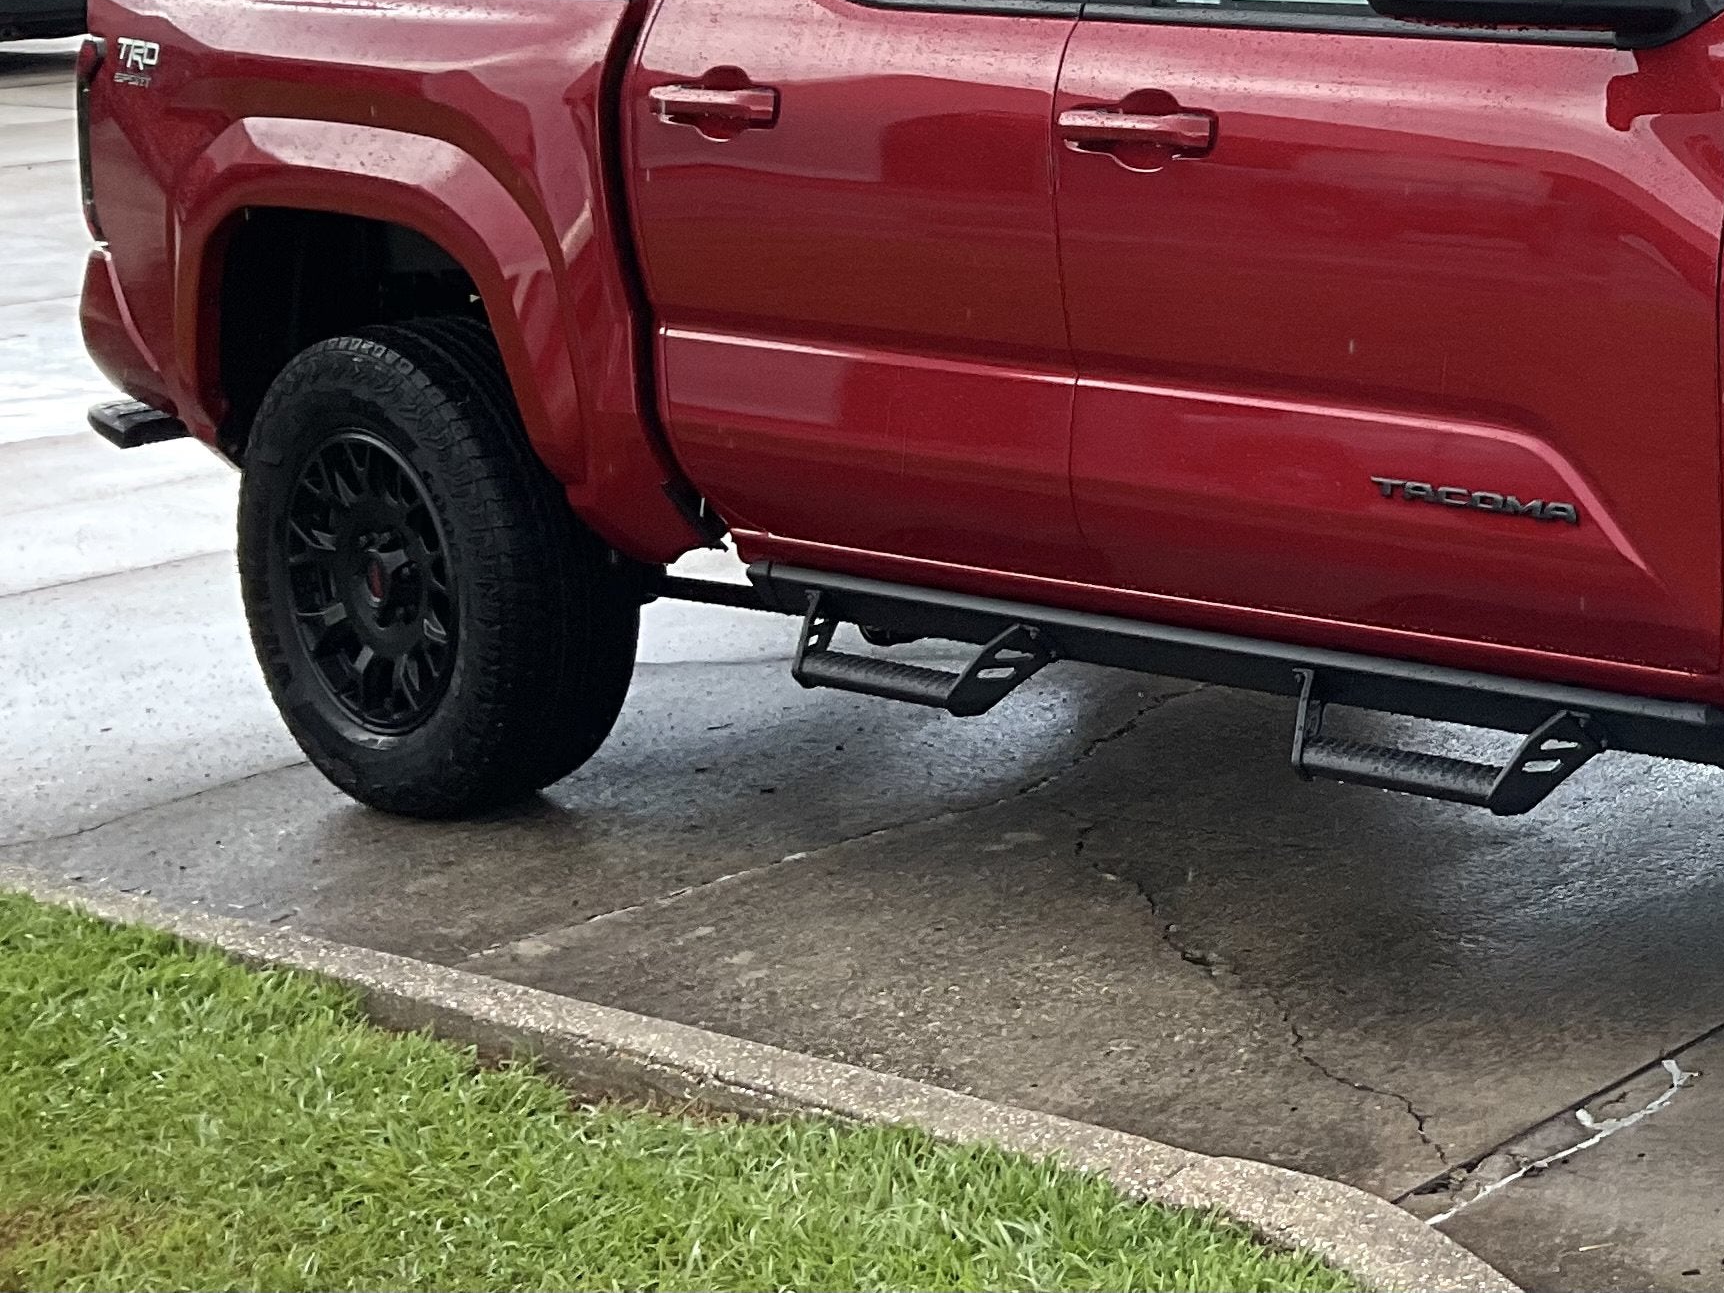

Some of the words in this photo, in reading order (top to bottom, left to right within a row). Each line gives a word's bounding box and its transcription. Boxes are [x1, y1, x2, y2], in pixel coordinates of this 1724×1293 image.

[117, 37, 160, 70] TRD
[113, 72, 152, 88] SPORT
[1370, 475, 1580, 524] TACOMA
